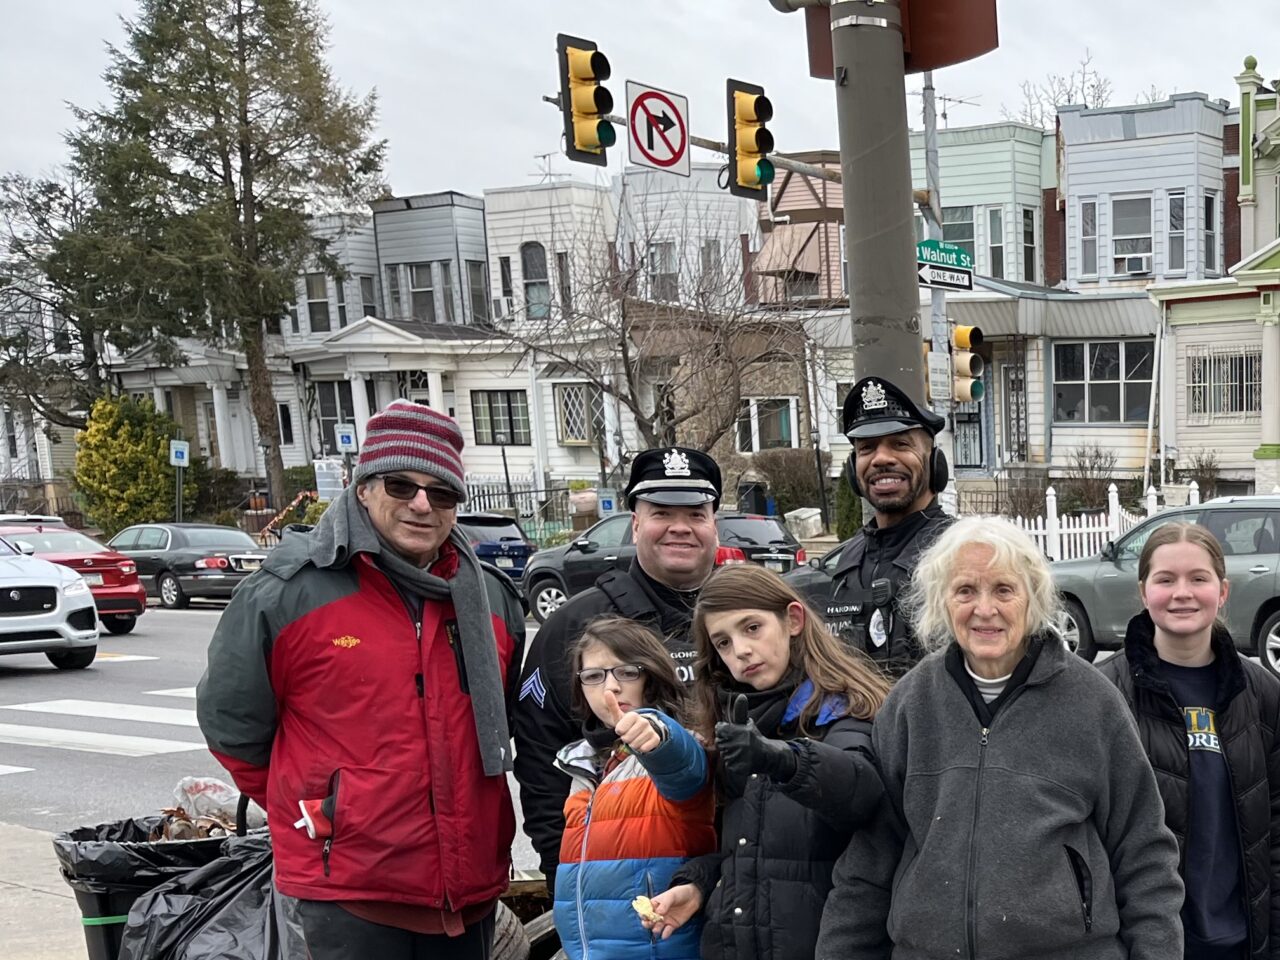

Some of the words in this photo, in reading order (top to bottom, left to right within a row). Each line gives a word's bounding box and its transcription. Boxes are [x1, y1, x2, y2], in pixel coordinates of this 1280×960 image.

[921, 246, 957, 265] Walnut
[960, 253, 971, 268] St
[930, 270, 947, 281] ONE
[949, 273, 966, 284] WAY
